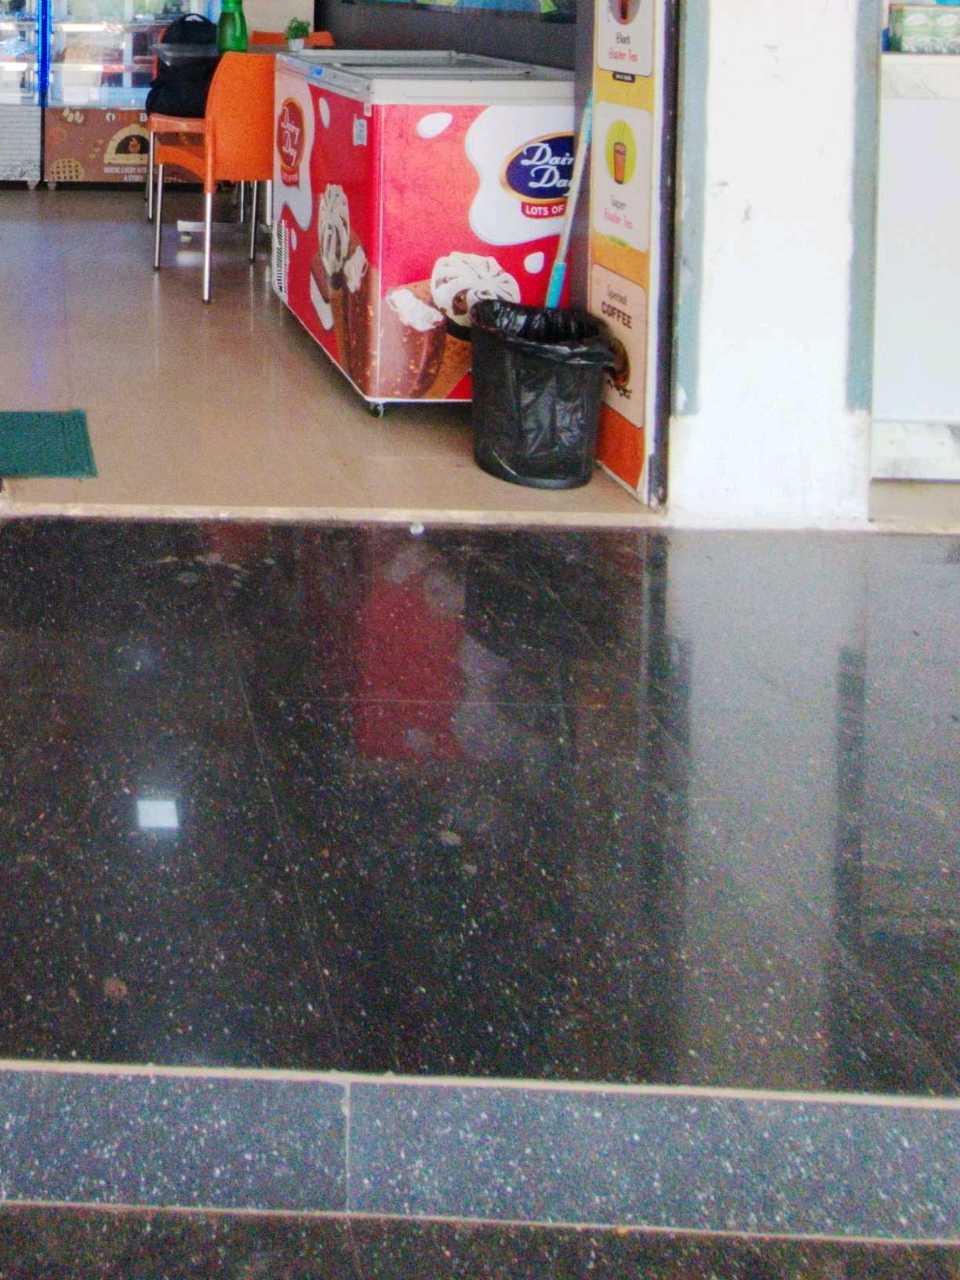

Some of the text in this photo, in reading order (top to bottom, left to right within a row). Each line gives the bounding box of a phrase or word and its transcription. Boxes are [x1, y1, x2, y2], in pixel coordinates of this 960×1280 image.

[520, 142, 574, 166] Dair
[528, 165, 572, 196] Da
[526, 204, 565, 216] LOTS OF
[601, 301, 632, 329] COFFEE
